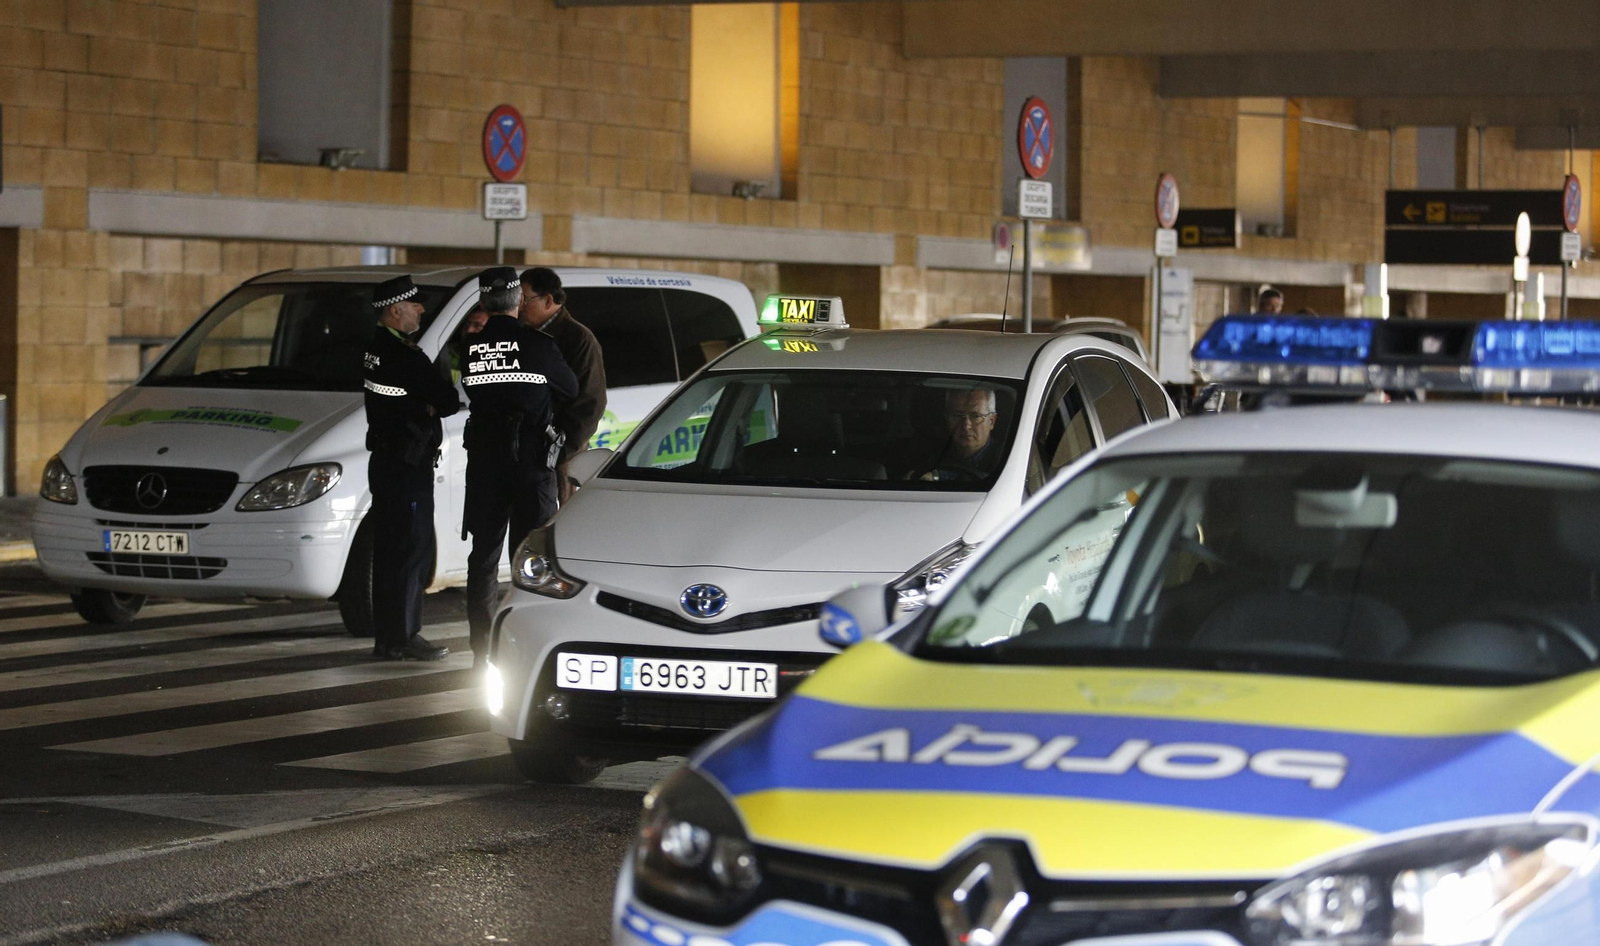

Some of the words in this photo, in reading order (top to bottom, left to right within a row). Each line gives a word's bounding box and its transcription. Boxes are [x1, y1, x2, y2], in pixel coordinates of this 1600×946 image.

[647, 277, 657, 285] de
[781, 299, 816, 319] TAXI
[469, 341, 520, 356] POLICIA
[480, 352, 506, 360] LOCAL
[468, 359, 521, 373] SEVILLA
[170, 410, 274, 427] PARKING
[113, 533, 150, 551] 7212
[156, 534, 184, 552] CTW
[640, 662, 706, 689] 6963
[718, 666, 769, 693] JTR
